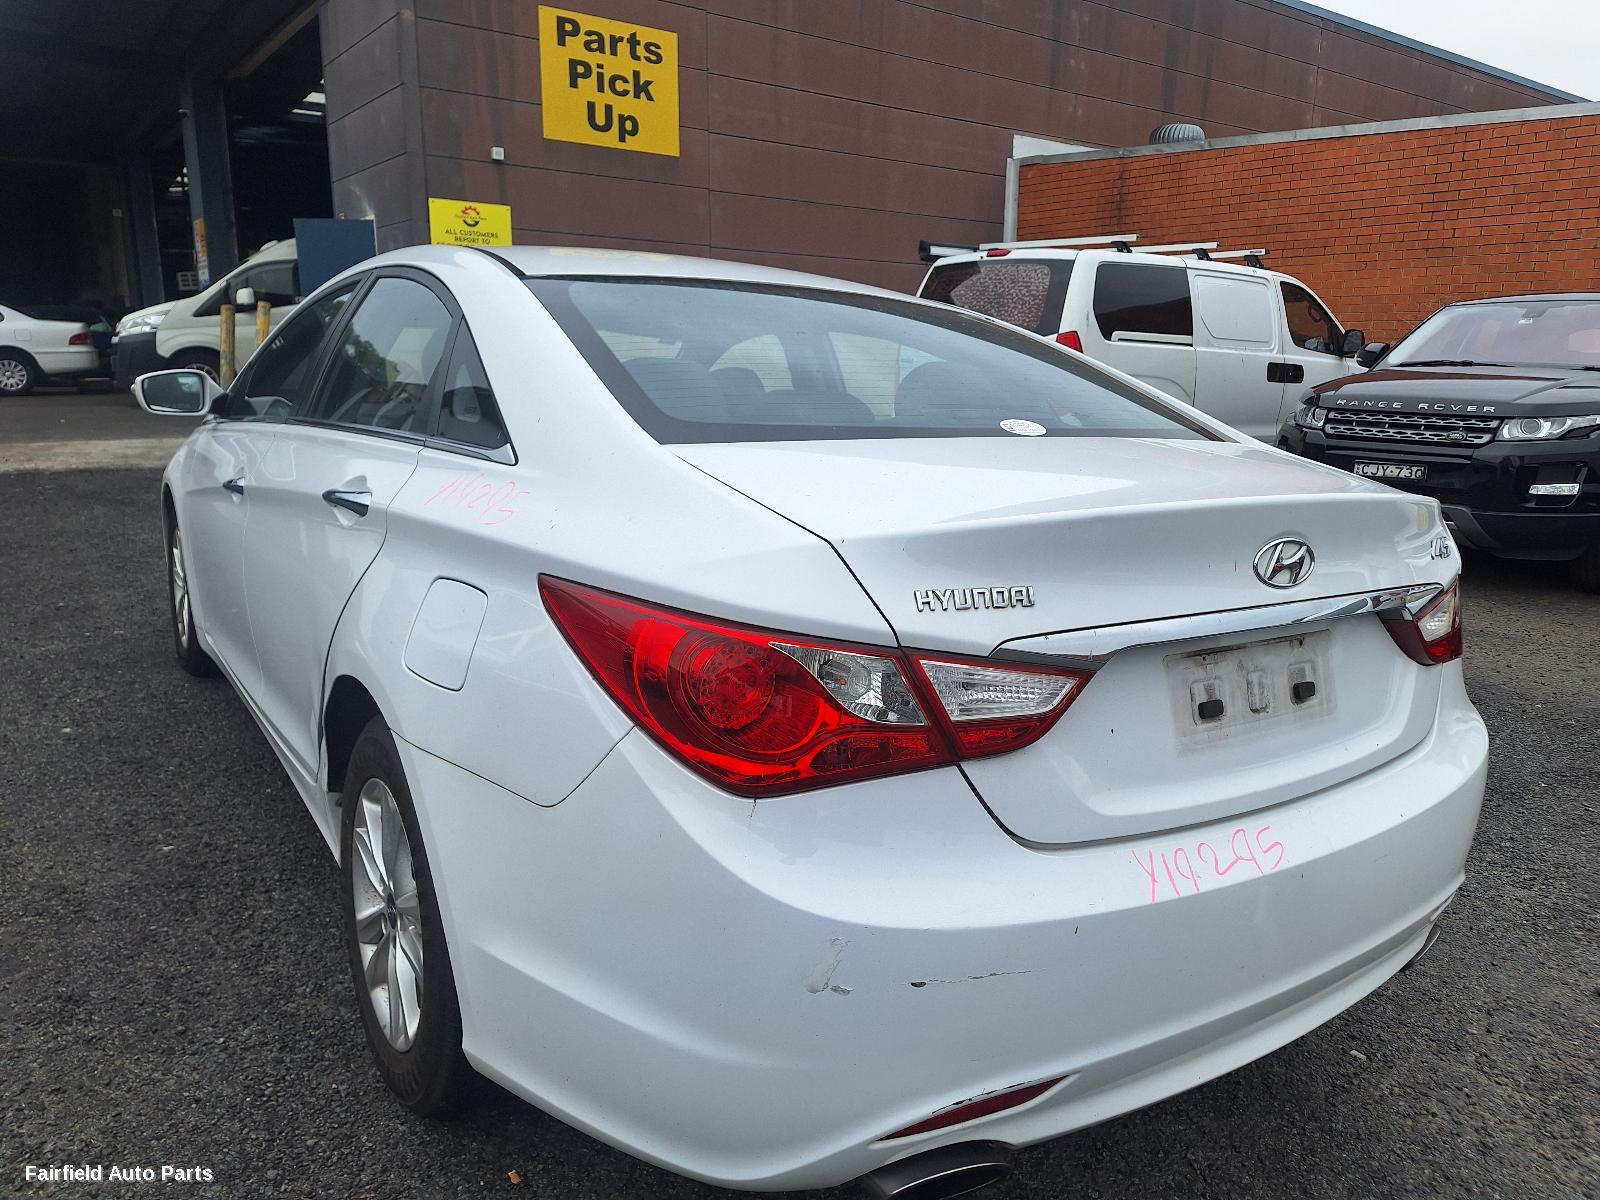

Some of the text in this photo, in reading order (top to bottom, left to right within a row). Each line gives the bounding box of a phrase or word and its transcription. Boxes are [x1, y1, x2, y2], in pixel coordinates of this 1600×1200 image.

[556, 15, 663, 65] Parts
[568, 57, 655, 102] Pick
[586, 100, 639, 143] Up
[445, 228, 498, 239] ALL CUSTOMERS
[454, 235, 479, 244] REPORT
[1336, 399, 1495, 413] RANGE ROVER
[914, 585, 1035, 613] HYUNDAI
[1131, 825, 1284, 904] Y19295
